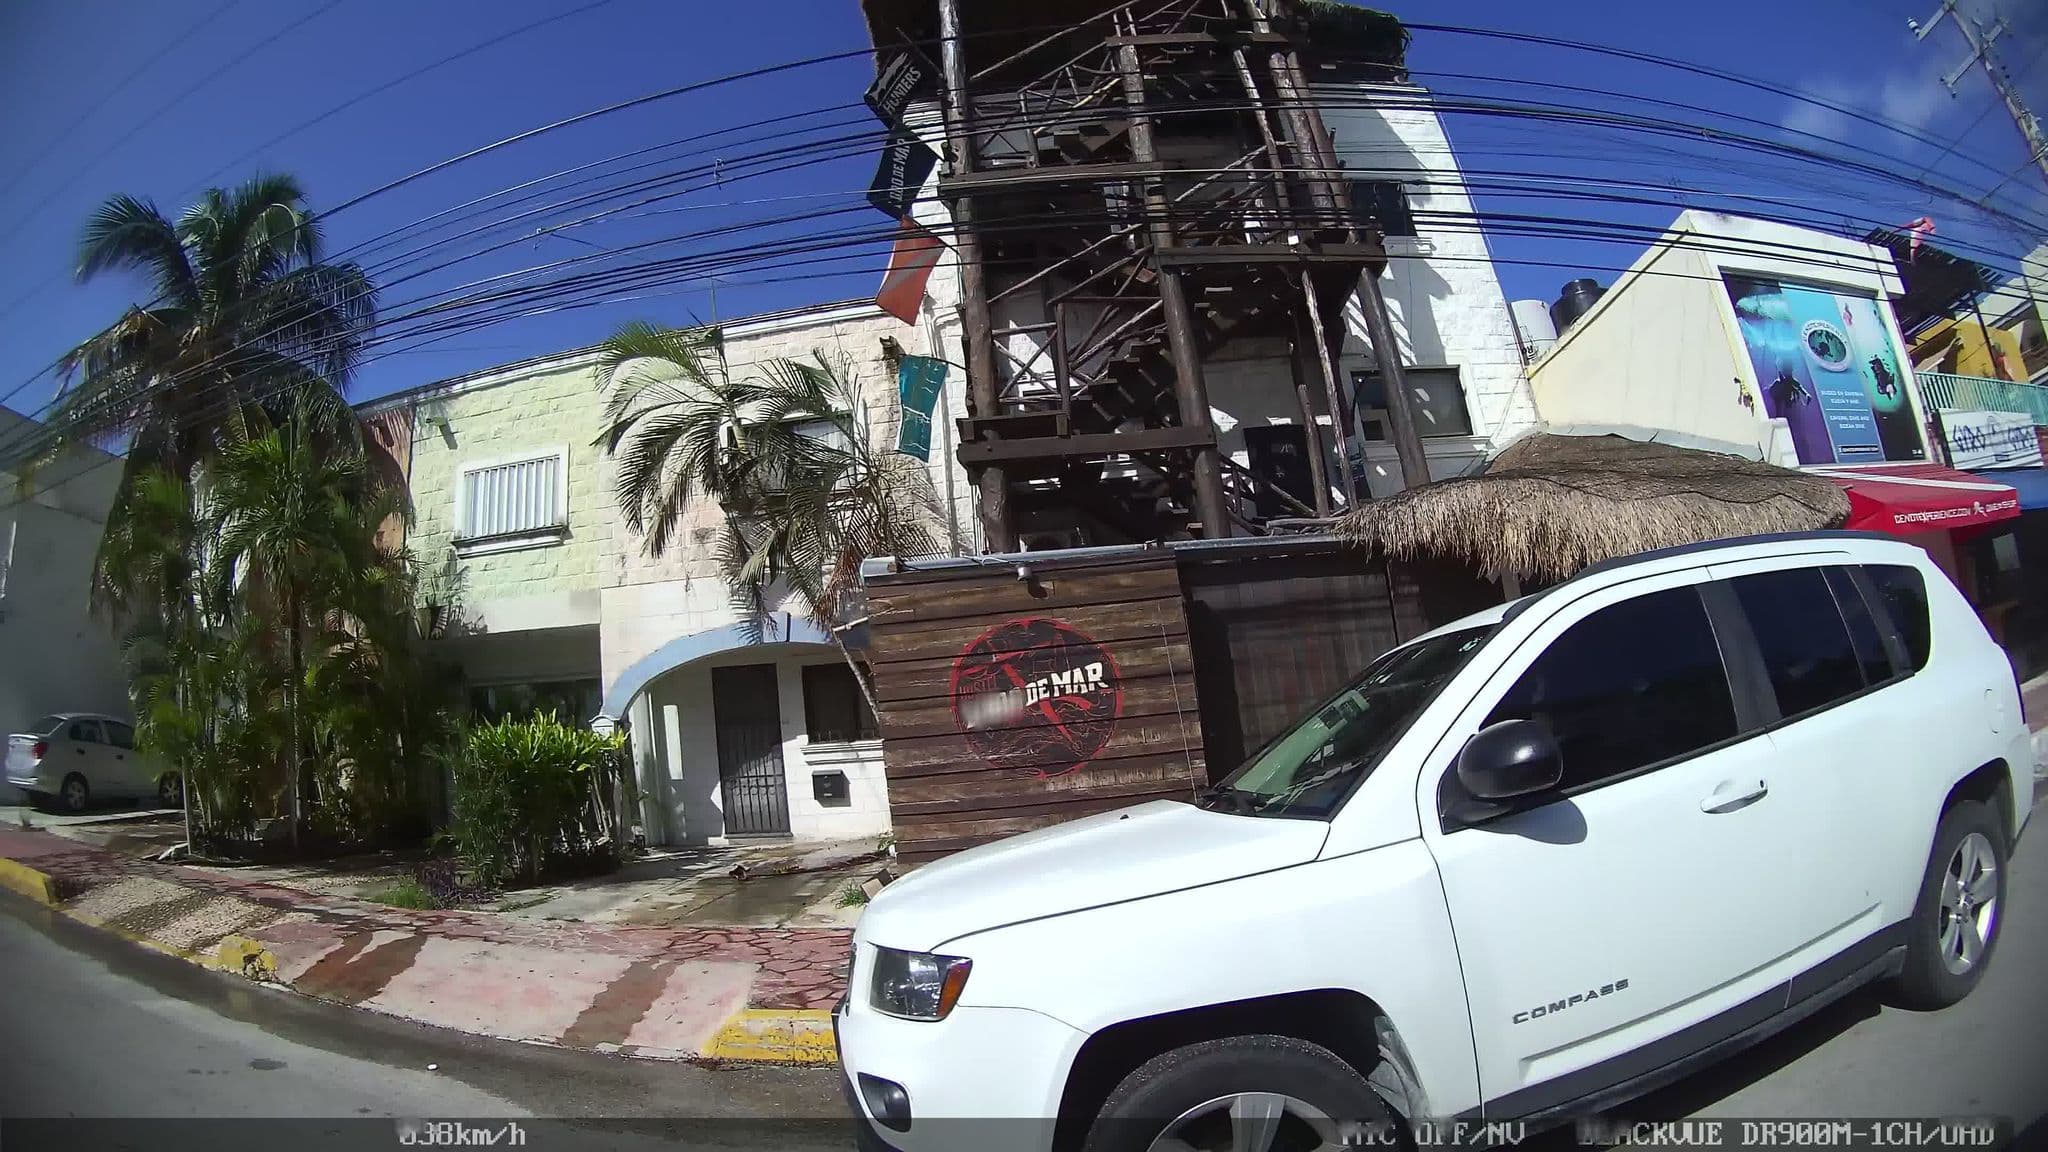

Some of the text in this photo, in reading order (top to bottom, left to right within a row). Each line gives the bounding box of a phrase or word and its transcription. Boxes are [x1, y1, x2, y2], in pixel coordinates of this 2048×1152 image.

[883, 66, 922, 116] HUNTERS
[1026, 662, 1109, 707] DE MAR
[1512, 979, 1629, 1024] COMPASS
